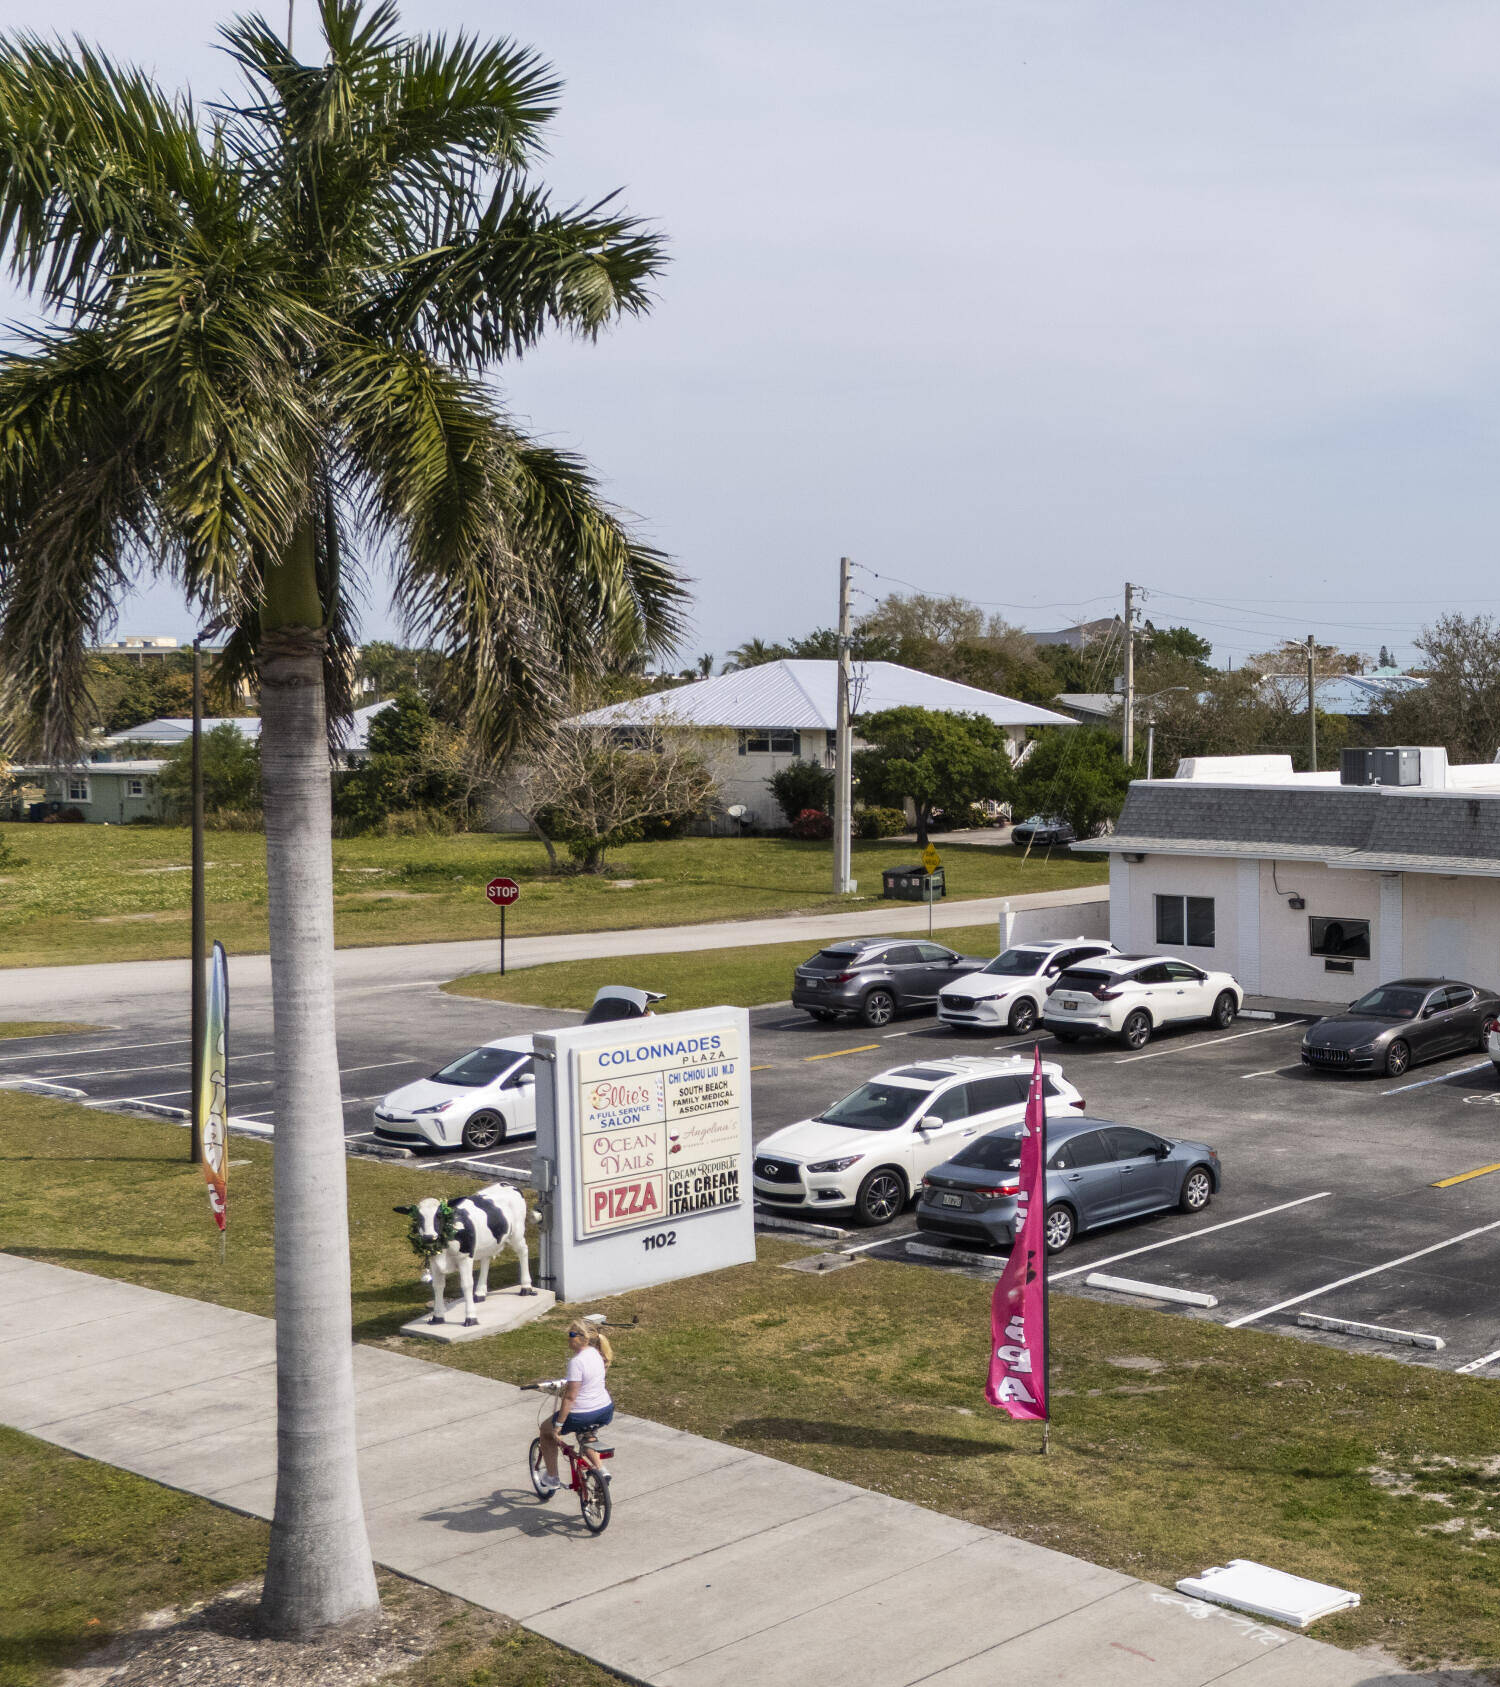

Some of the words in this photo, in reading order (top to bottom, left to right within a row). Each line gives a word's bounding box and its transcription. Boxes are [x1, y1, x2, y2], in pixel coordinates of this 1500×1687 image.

[488, 886, 518, 898] STOP
[598, 1035, 721, 1067] COLONNADES
[683, 1050, 725, 1065] PLAZA
[668, 1073, 681, 1085] CHI
[683, 1069, 705, 1082] CHIOU
[707, 1066, 719, 1078] LIU
[592, 1082, 649, 1110] Ellie's
[679, 1084, 703, 1097] SOUTH
[705, 1080, 728, 1092] BEACH
[673, 1096, 699, 1107] FAMILY
[702, 1090, 734, 1101] MEDICAL
[680, 1100, 729, 1114] ASSOCIATION
[597, 1111, 617, 1119] FULL
[618, 1105, 651, 1115] SERVICE
[600, 1114, 640, 1128] SALON
[669, 1180, 690, 1199] ICE
[694, 1170, 739, 1193] CREAM
[594, 1182, 658, 1221] PIZZA
[669, 1191, 717, 1216] ITALIAN
[719, 1186, 740, 1204] ICE
[642, 1231, 677, 1251] 1102
